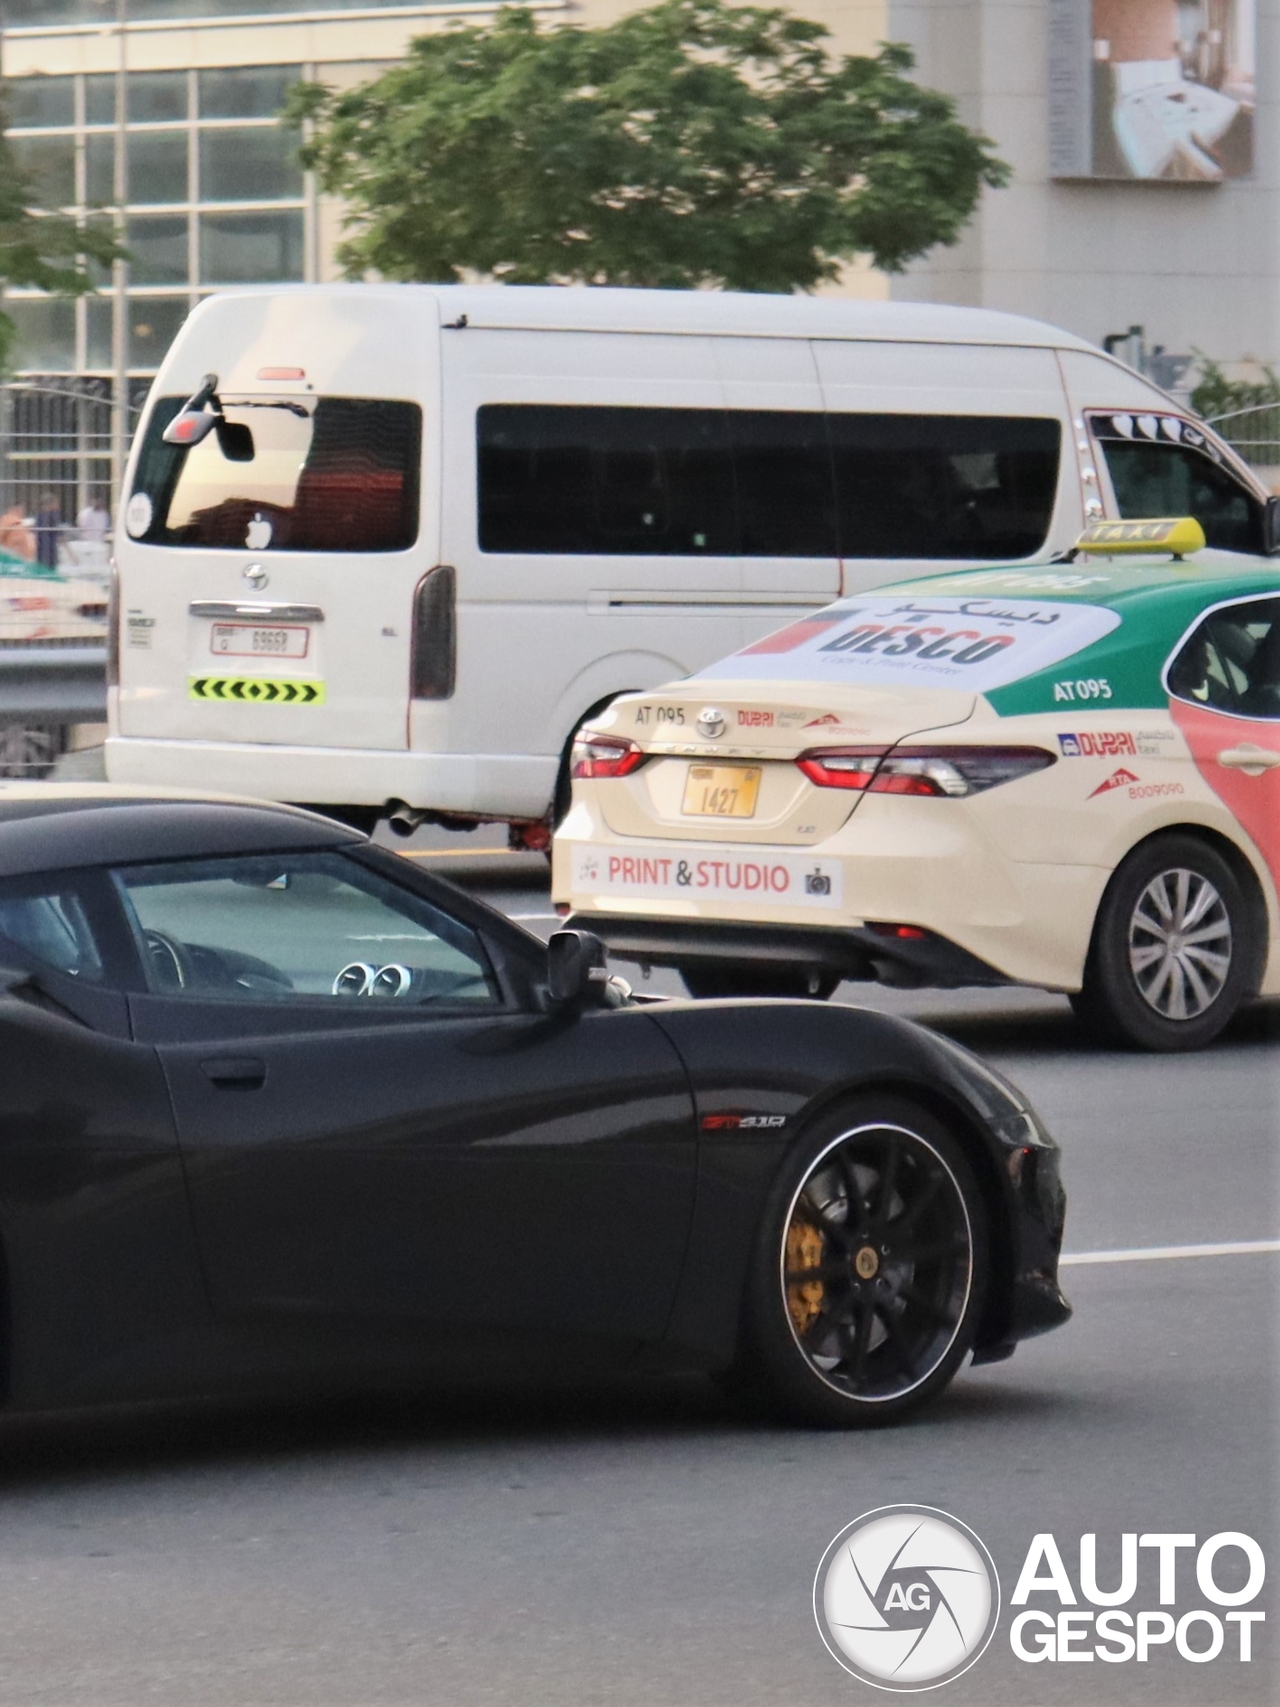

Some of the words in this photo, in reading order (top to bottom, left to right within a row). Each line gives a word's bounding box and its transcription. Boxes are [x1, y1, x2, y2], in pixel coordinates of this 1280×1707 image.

[1092, 523, 1166, 540] TAXI
[817, 624, 1016, 665] DESCO
[635, 706, 652, 725] AT
[657, 706, 685, 726] 095
[701, 787, 739, 814] 1427
[1128, 782, 1185, 800] 8009090
[608, 856, 672, 886] PRINT
[676, 860, 692, 886] &
[696, 861, 790, 893] STUDIO
